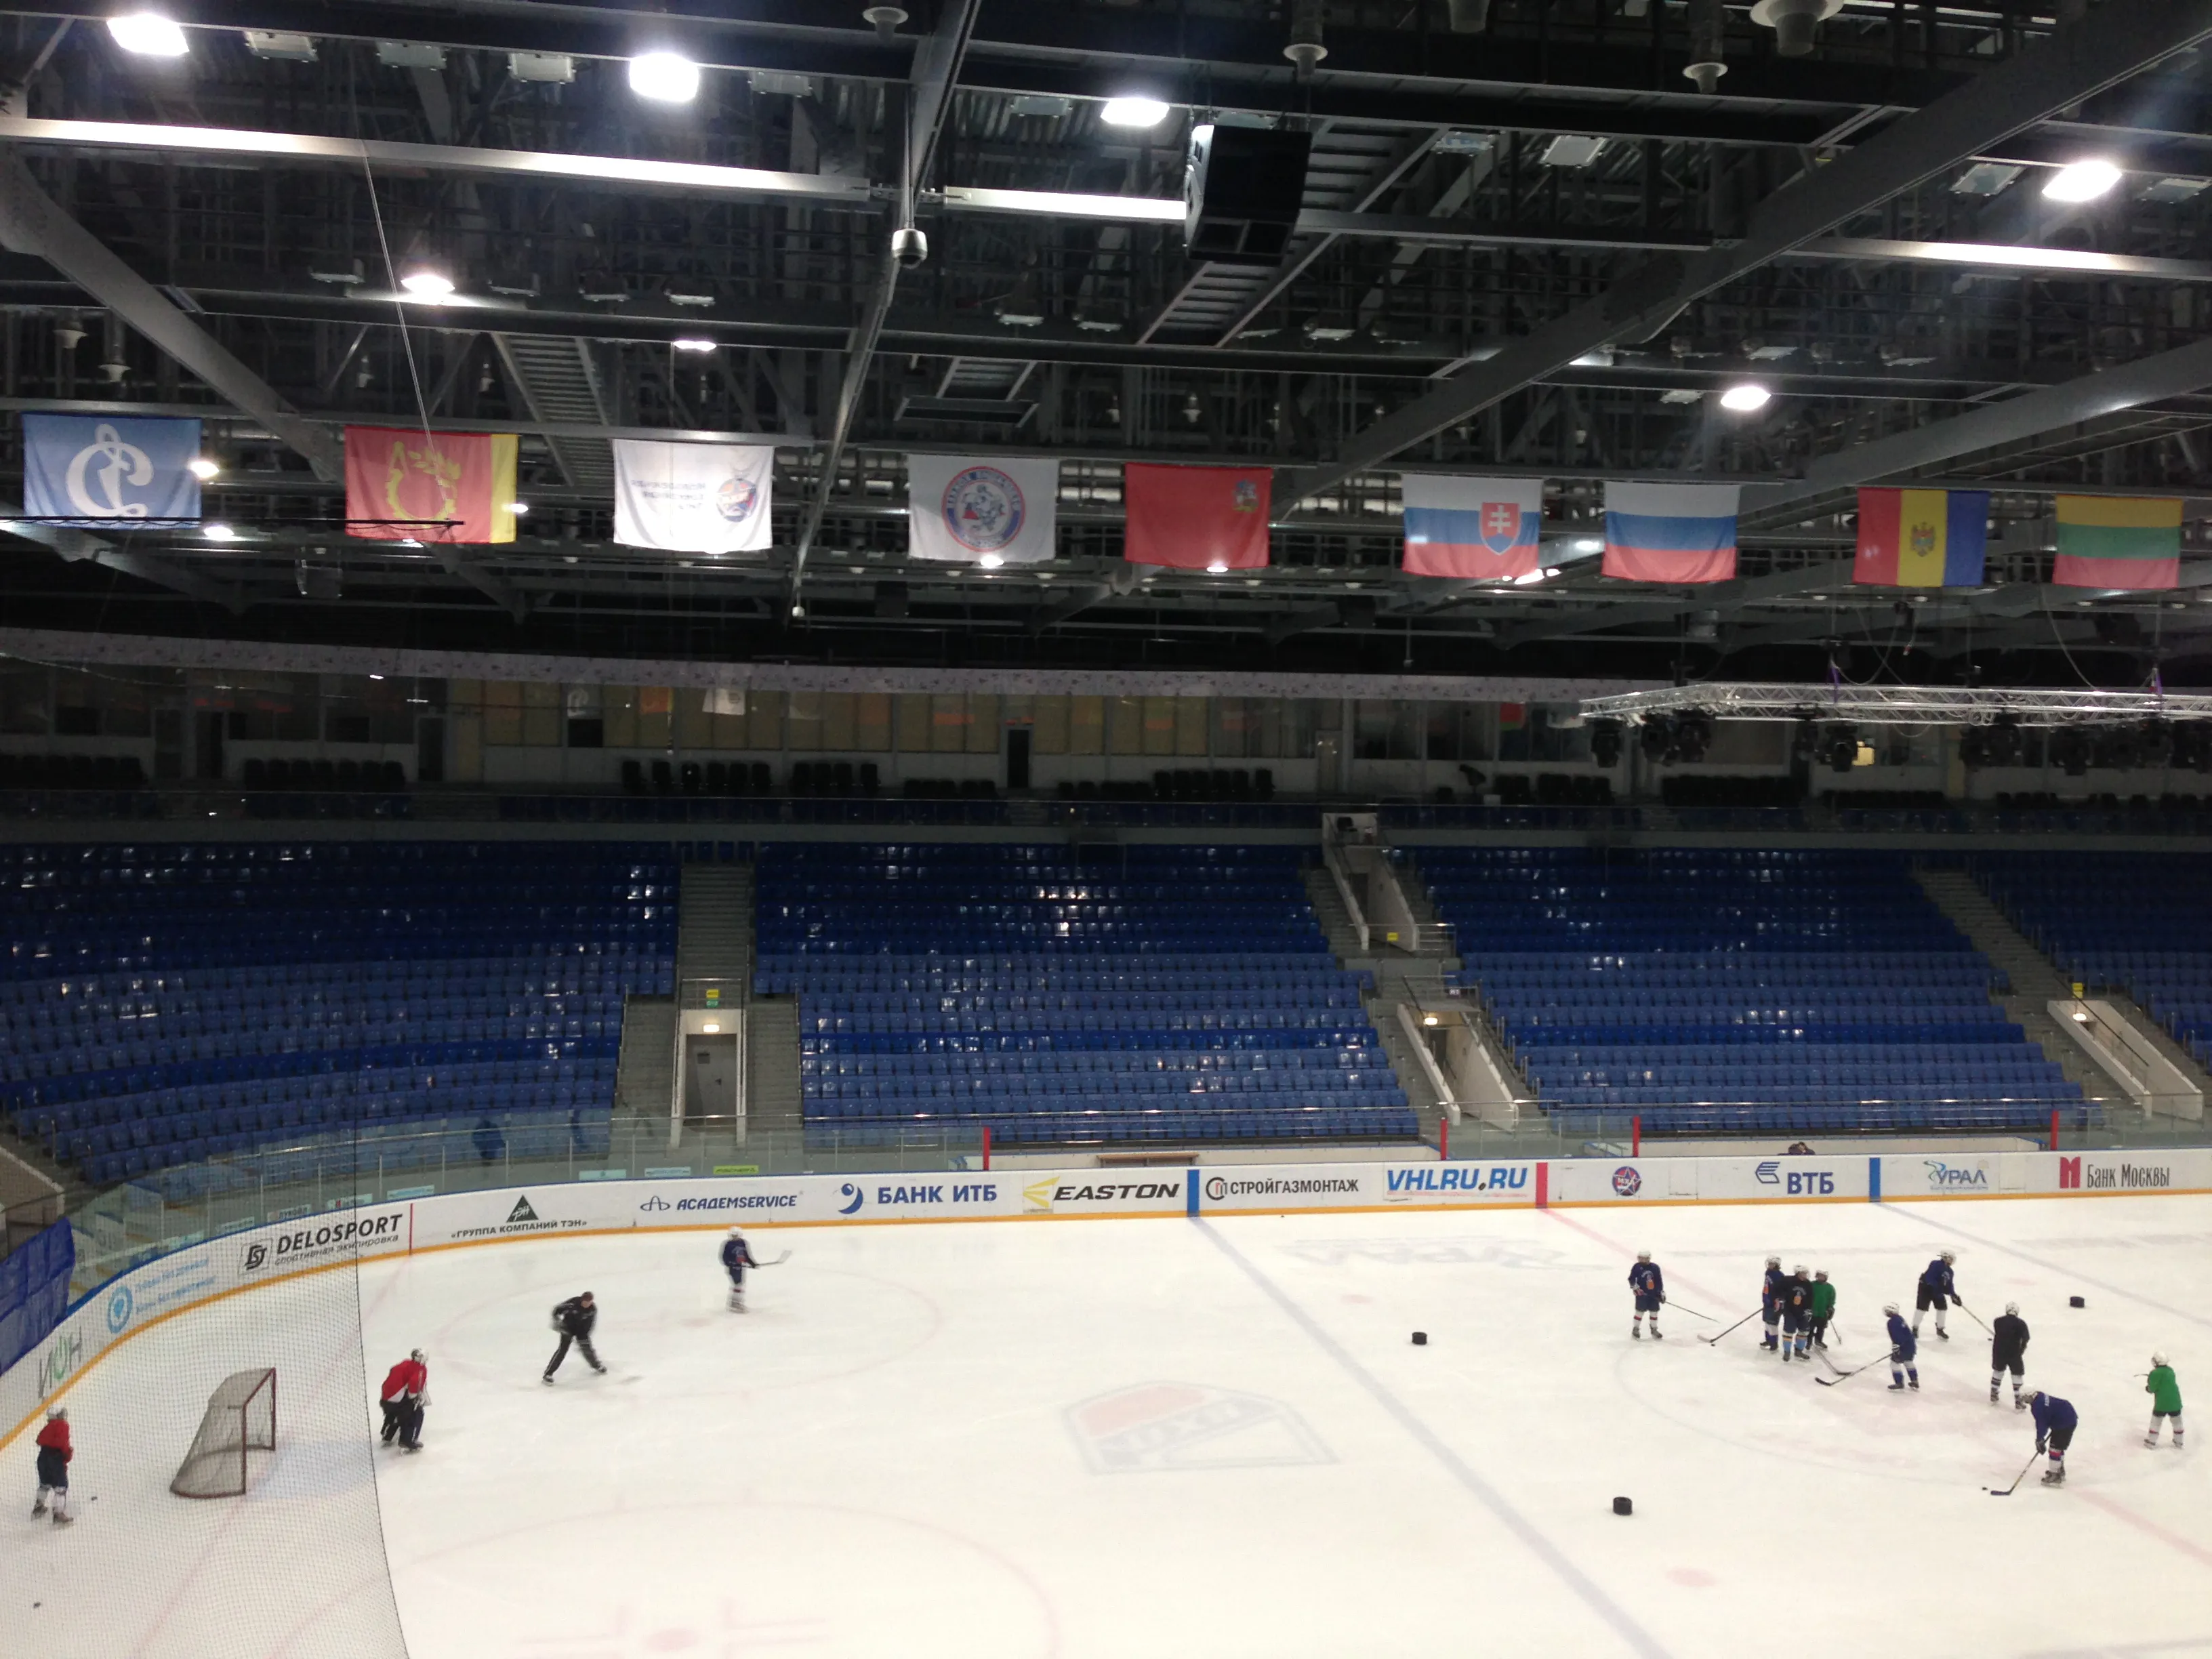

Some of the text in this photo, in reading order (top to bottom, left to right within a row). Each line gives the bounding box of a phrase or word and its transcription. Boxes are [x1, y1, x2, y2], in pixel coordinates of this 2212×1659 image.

[1230, 1178, 1359, 1195] СТРОЙГАЗМОНТАЖ
[1387, 1168, 1528, 1191] VHLRU.RU
[1787, 1171, 1835, 1195] ВТБ
[1936, 1169, 1988, 1185] УРАЛ
[2087, 1164, 2170, 1187] Банк Москвы
[877, 1183, 998, 1204] БАНК ИТБ
[1053, 1183, 1181, 1201] EASTON
[276, 1214, 403, 1254] DELOSPORT
[499, 1221, 558, 1233] КОМПАНИЙ
[274, 1233, 399, 1265] спортивная экипировка
